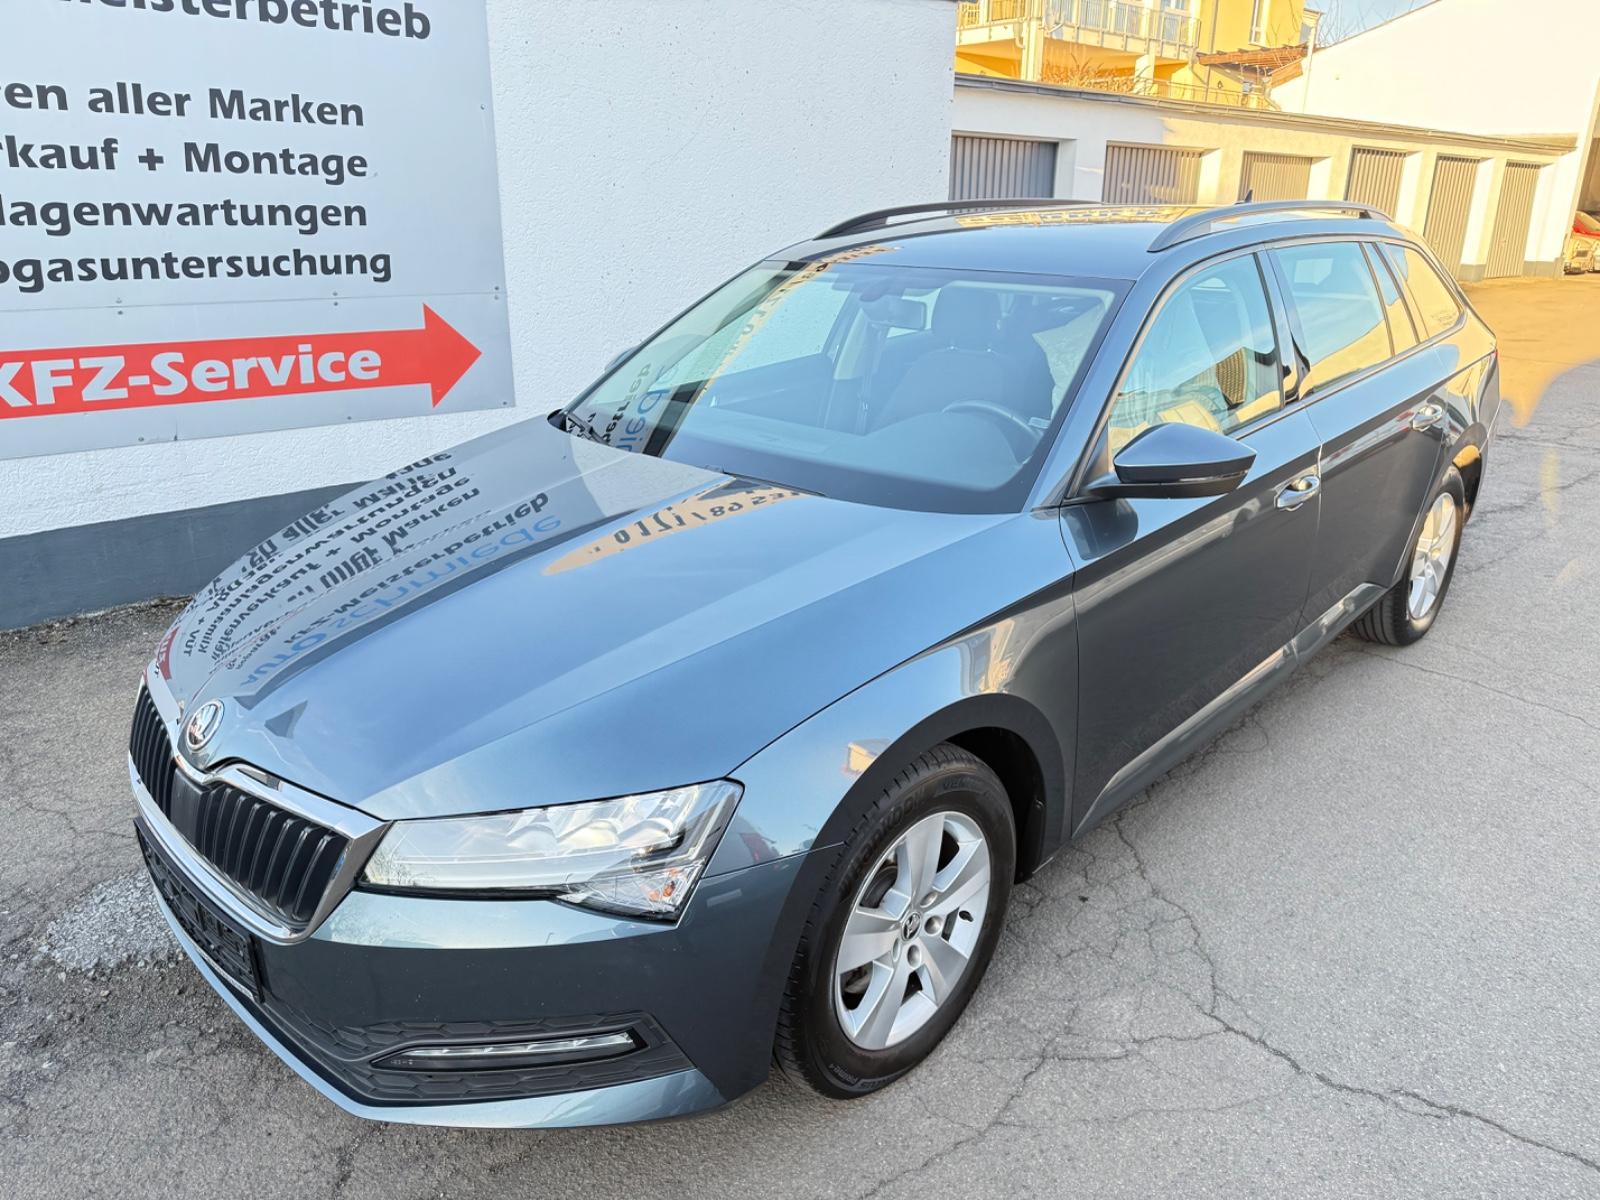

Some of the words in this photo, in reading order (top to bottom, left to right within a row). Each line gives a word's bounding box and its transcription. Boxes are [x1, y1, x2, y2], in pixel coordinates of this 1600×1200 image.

[58, 0, 431, 39] erbetrieb
[0, 82, 68, 110] en
[88, 81, 191, 117] aller
[208, 87, 364, 126] Marken
[0, 135, 118, 170] kauf
[138, 148, 164, 171] +
[183, 141, 368, 185] Montage
[0, 343, 382, 407] KFZ-Service
